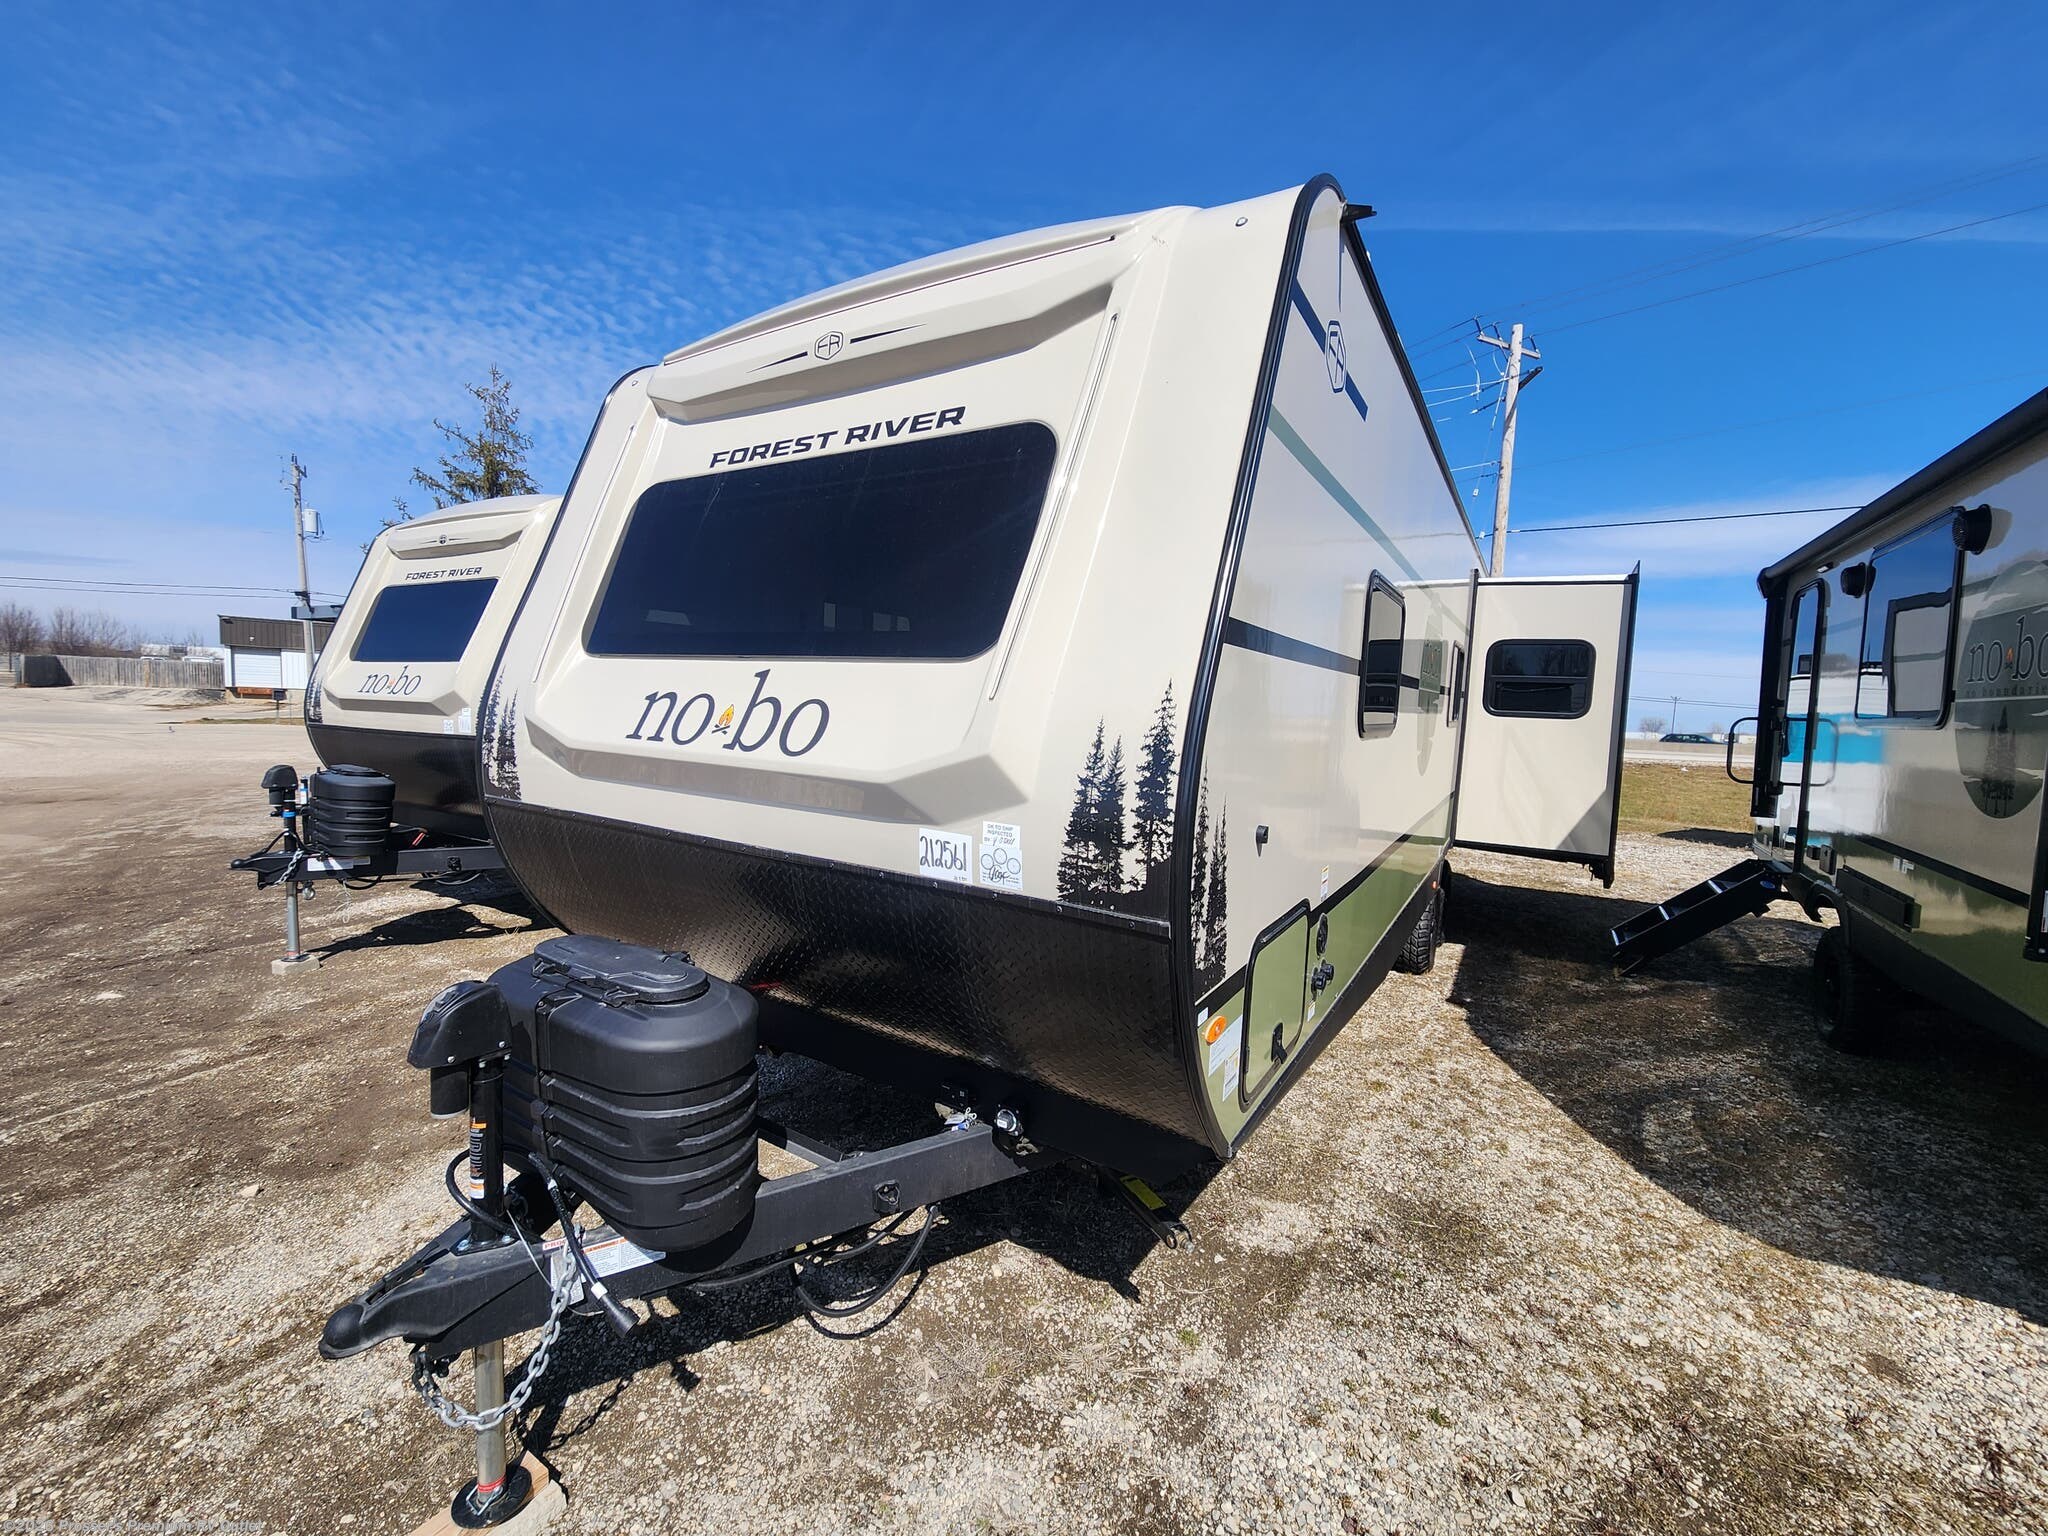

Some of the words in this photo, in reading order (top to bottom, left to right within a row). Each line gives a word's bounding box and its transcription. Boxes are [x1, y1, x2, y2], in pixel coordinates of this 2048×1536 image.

[709, 430, 839, 469] FOREST
[844, 406, 966, 445] RIVER
[405, 570, 445, 581] FOREST
[447, 566, 483, 577] RIVER
[919, 835, 967, 872] 212561
